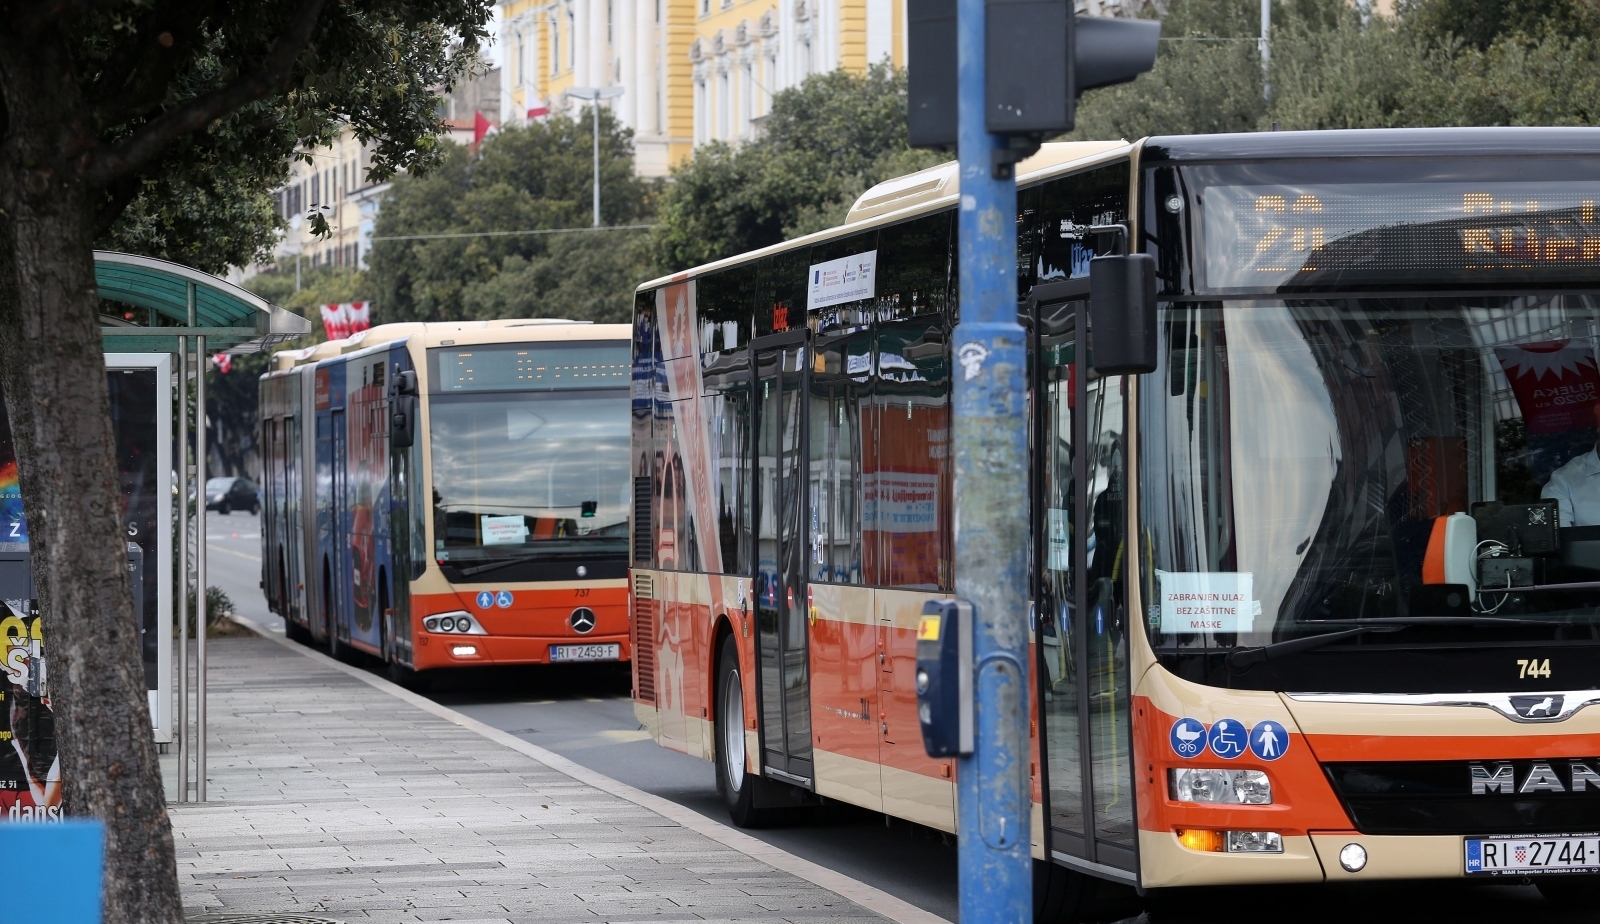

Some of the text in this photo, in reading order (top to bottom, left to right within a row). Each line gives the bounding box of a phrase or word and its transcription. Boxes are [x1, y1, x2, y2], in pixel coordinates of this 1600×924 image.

[574, 588, 590, 598] 737
[1168, 593, 1244, 601] ZABRANJEN ULAZ
[1176, 605, 1236, 615] BEZ ZAŠTITNE
[1190, 620, 1222, 629] MASKE
[557, 645, 614, 659] RI 2459-F
[1517, 659, 1551, 679] 744
[1471, 763, 1600, 794] MAN
[1483, 840, 1600, 867] RI 2744-
